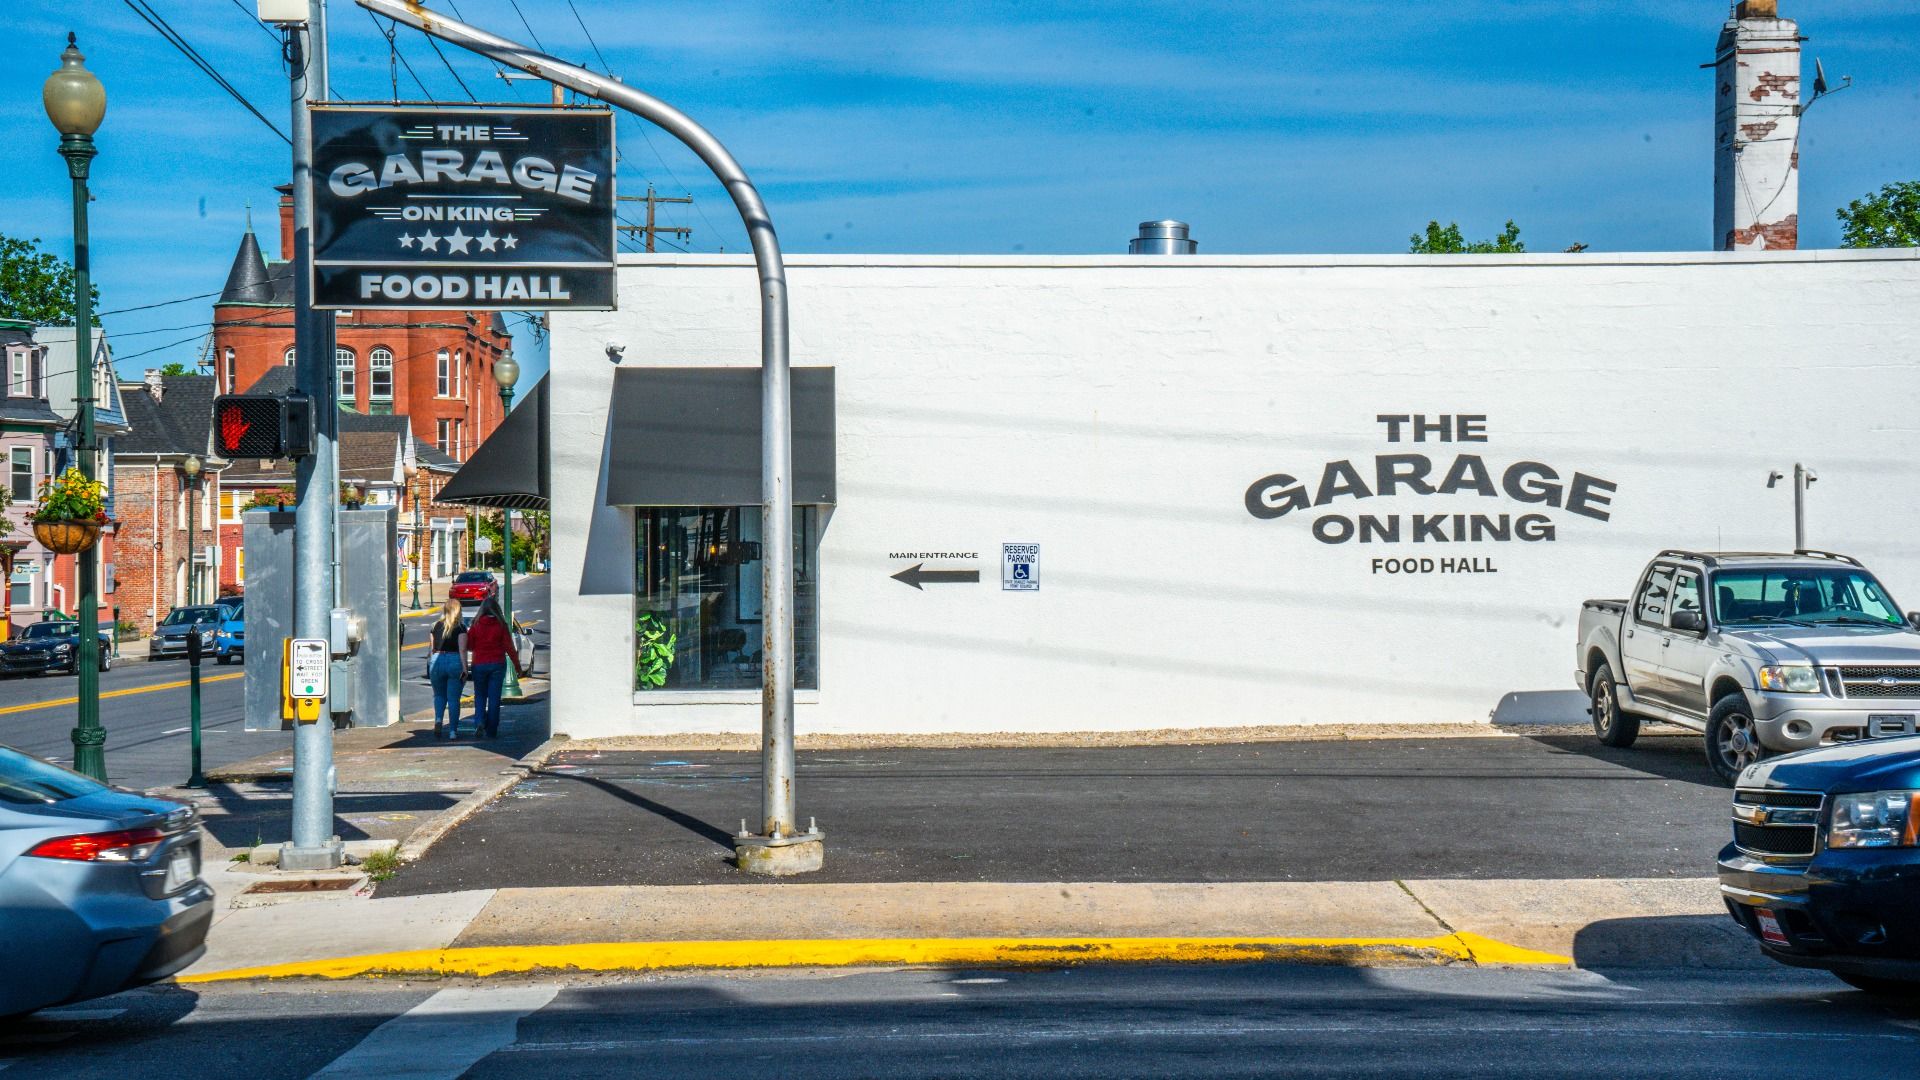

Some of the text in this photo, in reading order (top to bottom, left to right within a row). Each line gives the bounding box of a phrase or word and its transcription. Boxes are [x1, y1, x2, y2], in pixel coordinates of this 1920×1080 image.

[437, 125, 490, 141] THE
[328, 149, 597, 204] GARAGE
[402, 206, 514, 222] ON KING
[361, 275, 570, 300] FOOD HALL
[1376, 414, 1488, 443] THE
[1245, 453, 1618, 523] GARAGE
[1312, 513, 1556, 545] ON KING
[1004, 545, 1038, 554] RESERVED
[1007, 554, 1036, 563] PARKING
[1372, 557, 1498, 574] FOOD HALL
